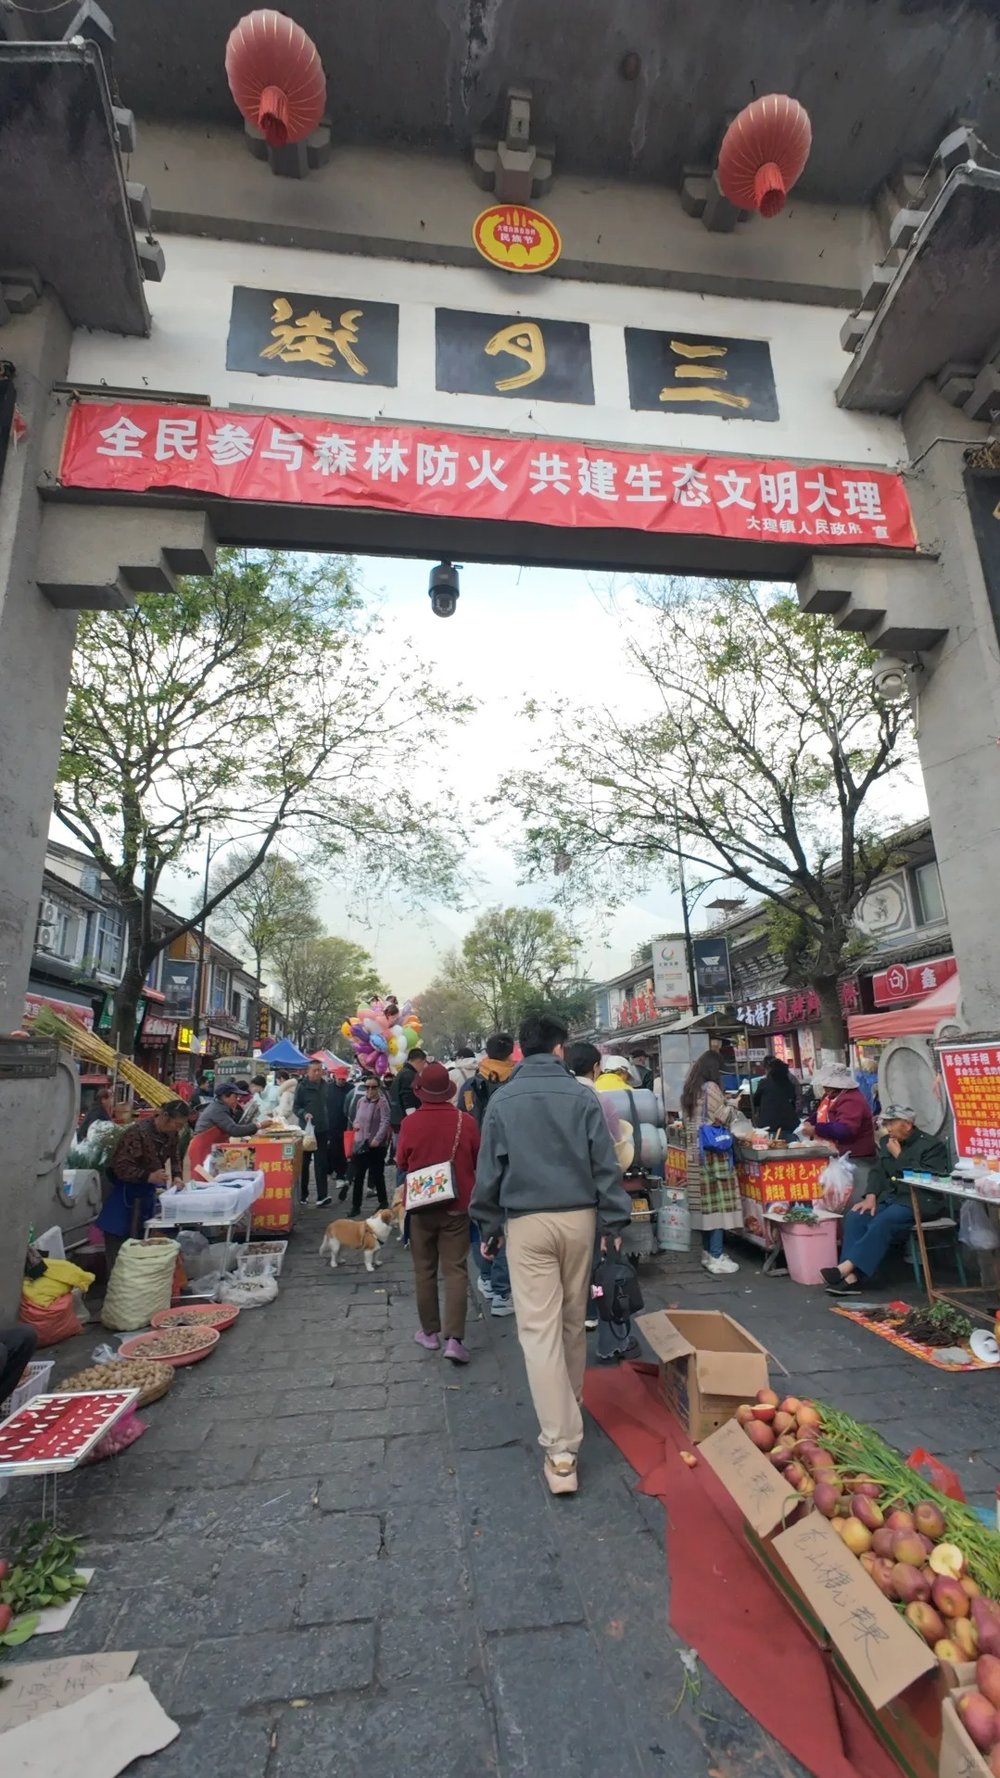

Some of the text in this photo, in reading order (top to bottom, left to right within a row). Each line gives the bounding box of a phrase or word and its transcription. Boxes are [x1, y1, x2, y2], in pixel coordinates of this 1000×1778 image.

[500, 233, 534, 244] 民族节
[96, 415, 886, 521] 全民参与森林防火 共建生态文明大理
[746, 516, 863, 536] 大理镇人民政府
